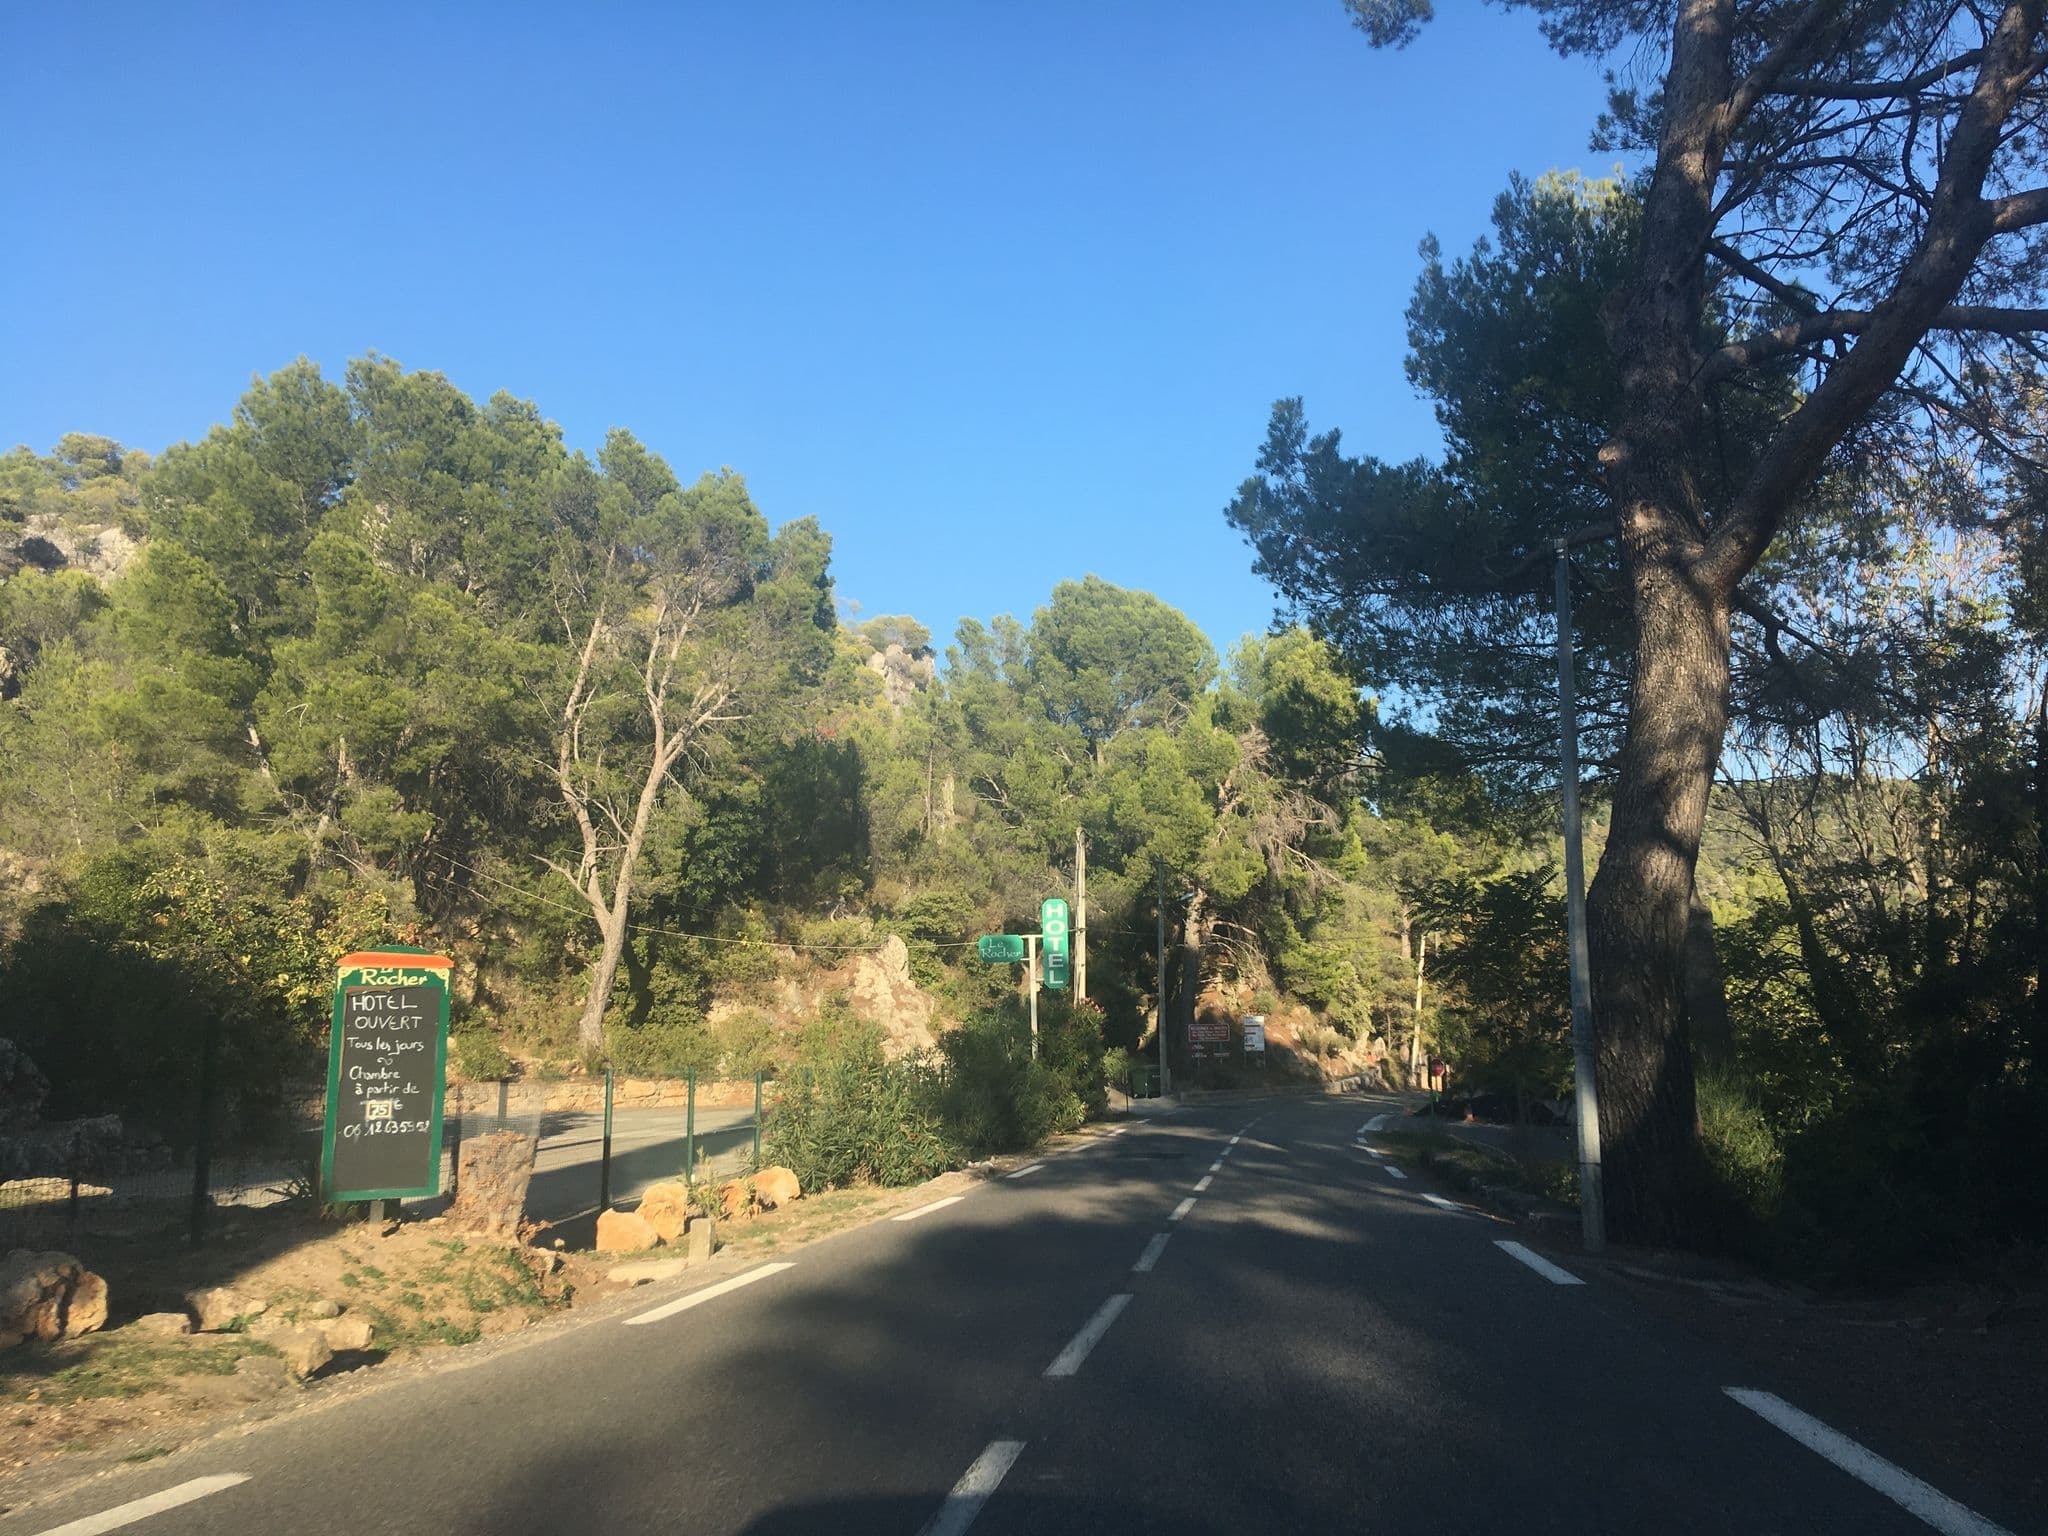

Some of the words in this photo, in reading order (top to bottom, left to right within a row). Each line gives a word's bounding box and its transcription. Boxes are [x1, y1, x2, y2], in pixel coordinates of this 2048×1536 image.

[988, 938, 1004, 948] Le
[1045, 903, 1066, 984] HOTEL
[981, 947, 1023, 959] Rocher
[360, 968, 428, 986] Rocher
[354, 1015, 423, 1031] OUVERT
[347, 1037, 373, 1051] Tous
[376, 1037, 391, 1051] les
[388, 1040, 425, 1056] jours
[349, 1066, 401, 1080] Chambre
[355, 1082, 363, 1095] à
[366, 1081, 400, 1099] partir
[402, 1081, 420, 1094] de
